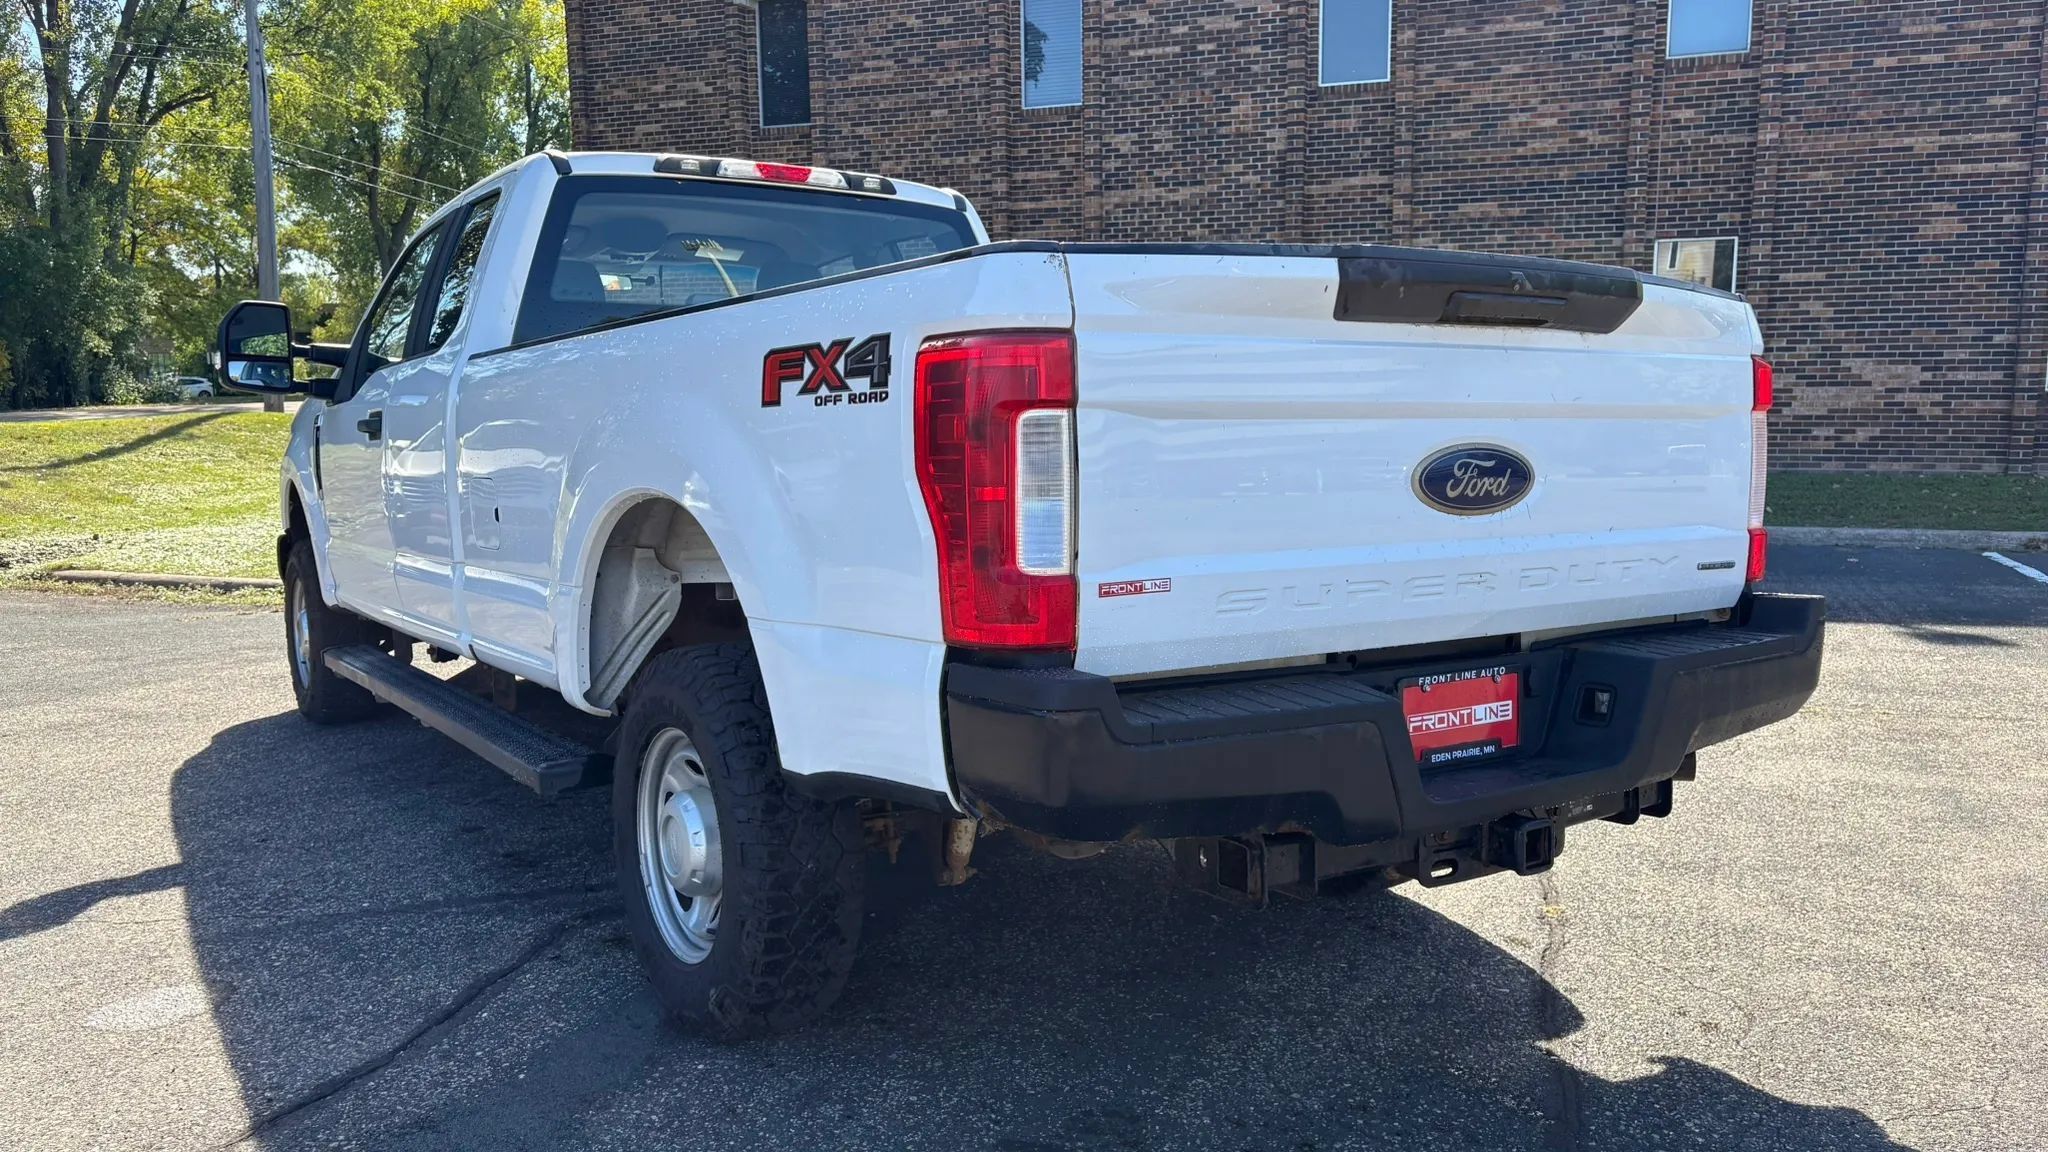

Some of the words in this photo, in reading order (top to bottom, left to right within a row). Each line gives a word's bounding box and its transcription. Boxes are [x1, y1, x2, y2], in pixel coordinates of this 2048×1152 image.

[760, 331, 892, 408] FX4
[814, 394, 843, 407] OFF
[847, 390, 889, 405] ROAD
[1445, 458, 1512, 498] Ford
[1215, 571, 1498, 617] SUPER
[1518, 554, 1680, 589] DUTY
[1418, 673, 1452, 687] FRONT
[1454, 670, 1477, 682] LINE
[1480, 666, 1506, 678] AUTO
[1431, 752, 1452, 763] EDEN
[1452, 747, 1483, 760] PRAIRIE,
[1483, 745, 1495, 754] MN
